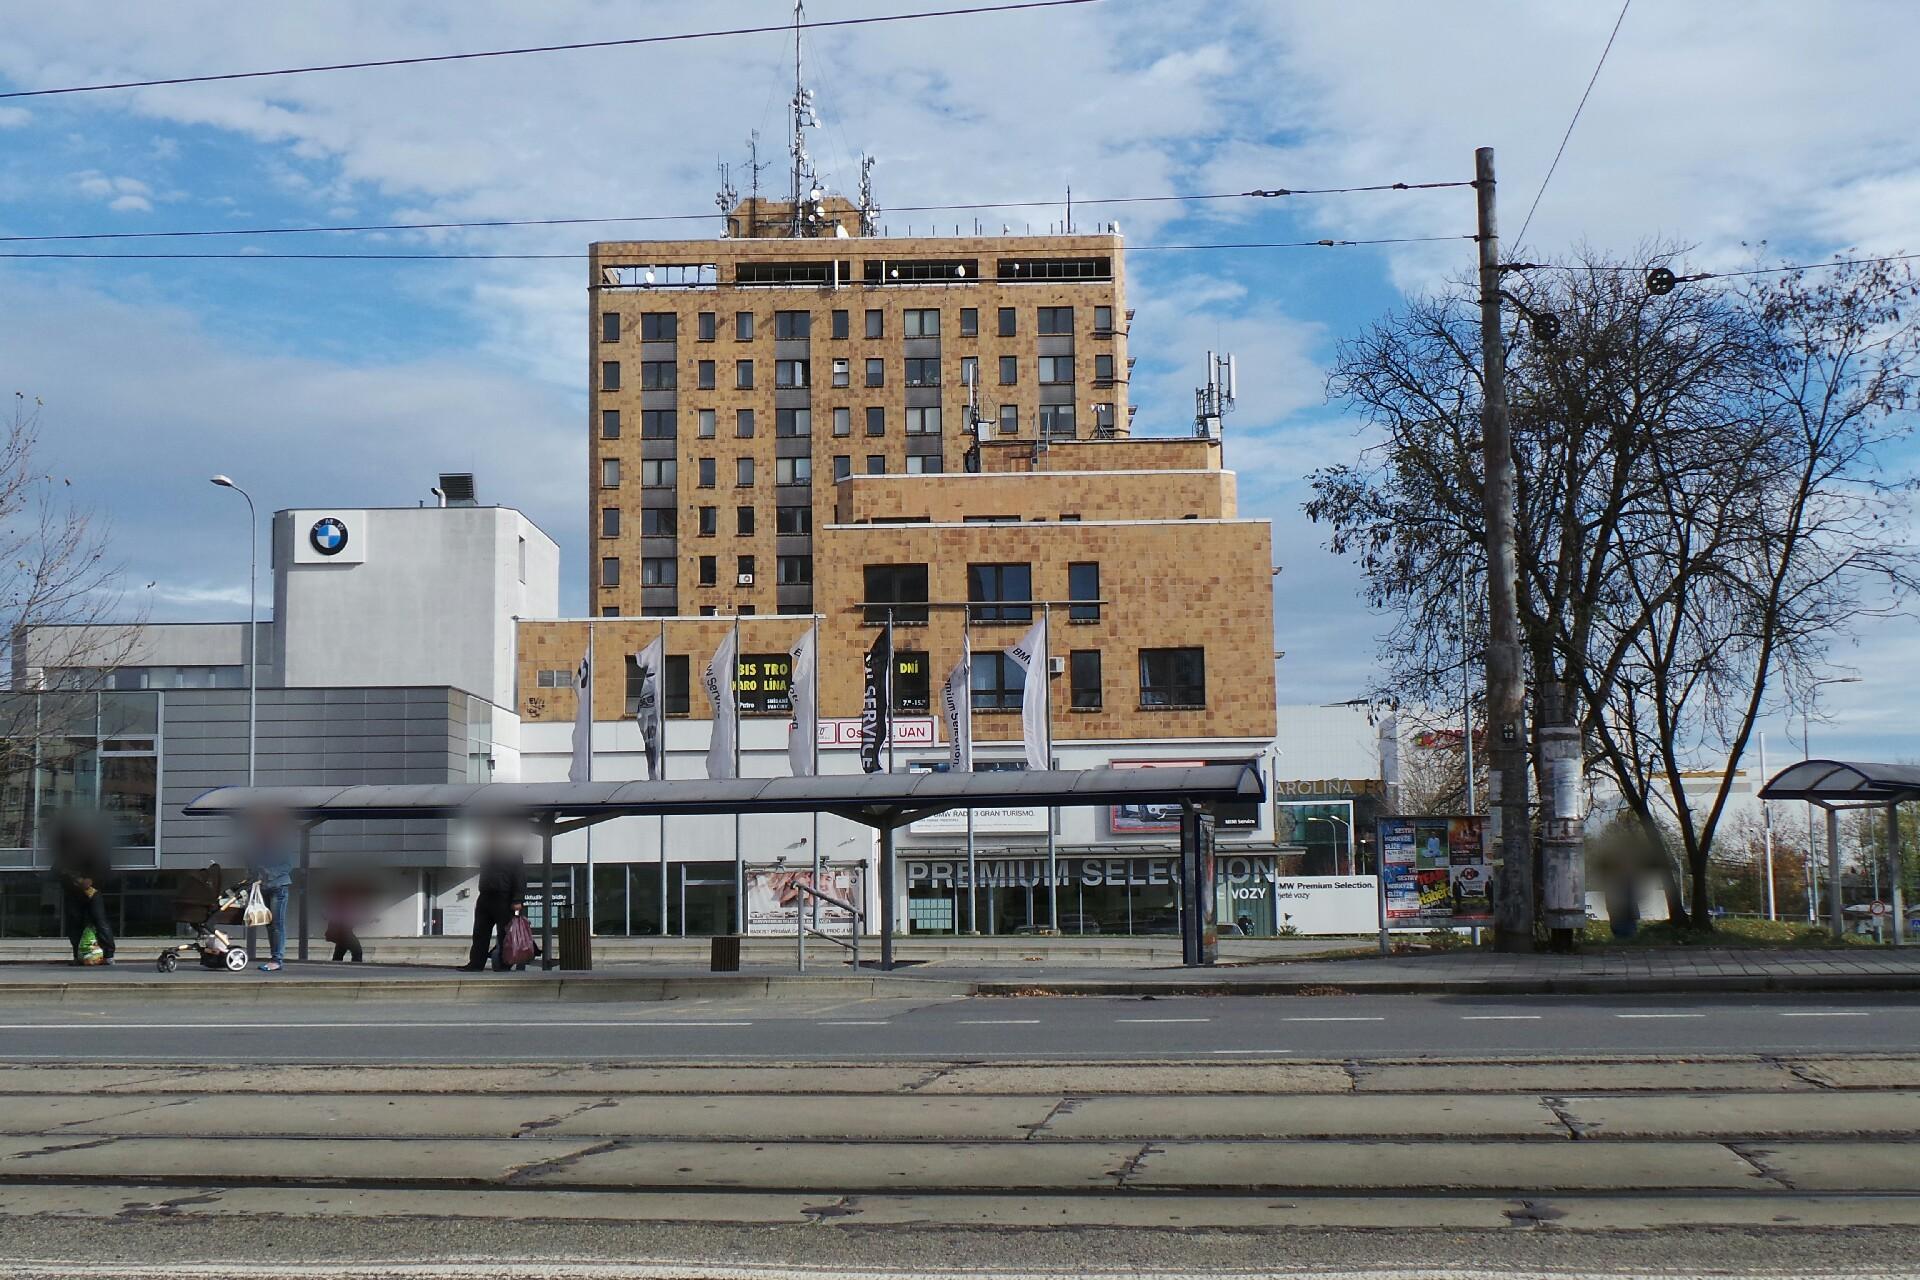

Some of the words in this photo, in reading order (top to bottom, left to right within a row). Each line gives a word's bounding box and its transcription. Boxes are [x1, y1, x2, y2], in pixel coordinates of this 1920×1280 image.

[763, 663, 788, 676] TRO
[900, 660, 919, 674] DNÍ
[763, 677, 787, 691] LÍNA
[861, 685, 877, 769] SERVICE
[898, 724, 925, 738] ÚAN
[1503, 723, 1514, 731] 26
[1503, 731, 1514, 739] 12
[1276, 781, 1354, 795] AROLINA
[908, 860, 1070, 889] PREMIUM
[1081, 856, 1276, 887] SELEION
[1297, 882, 1333, 890] Premium
[1334, 882, 1375, 890] Selection.
[1293, 892, 1310, 900] vozy
